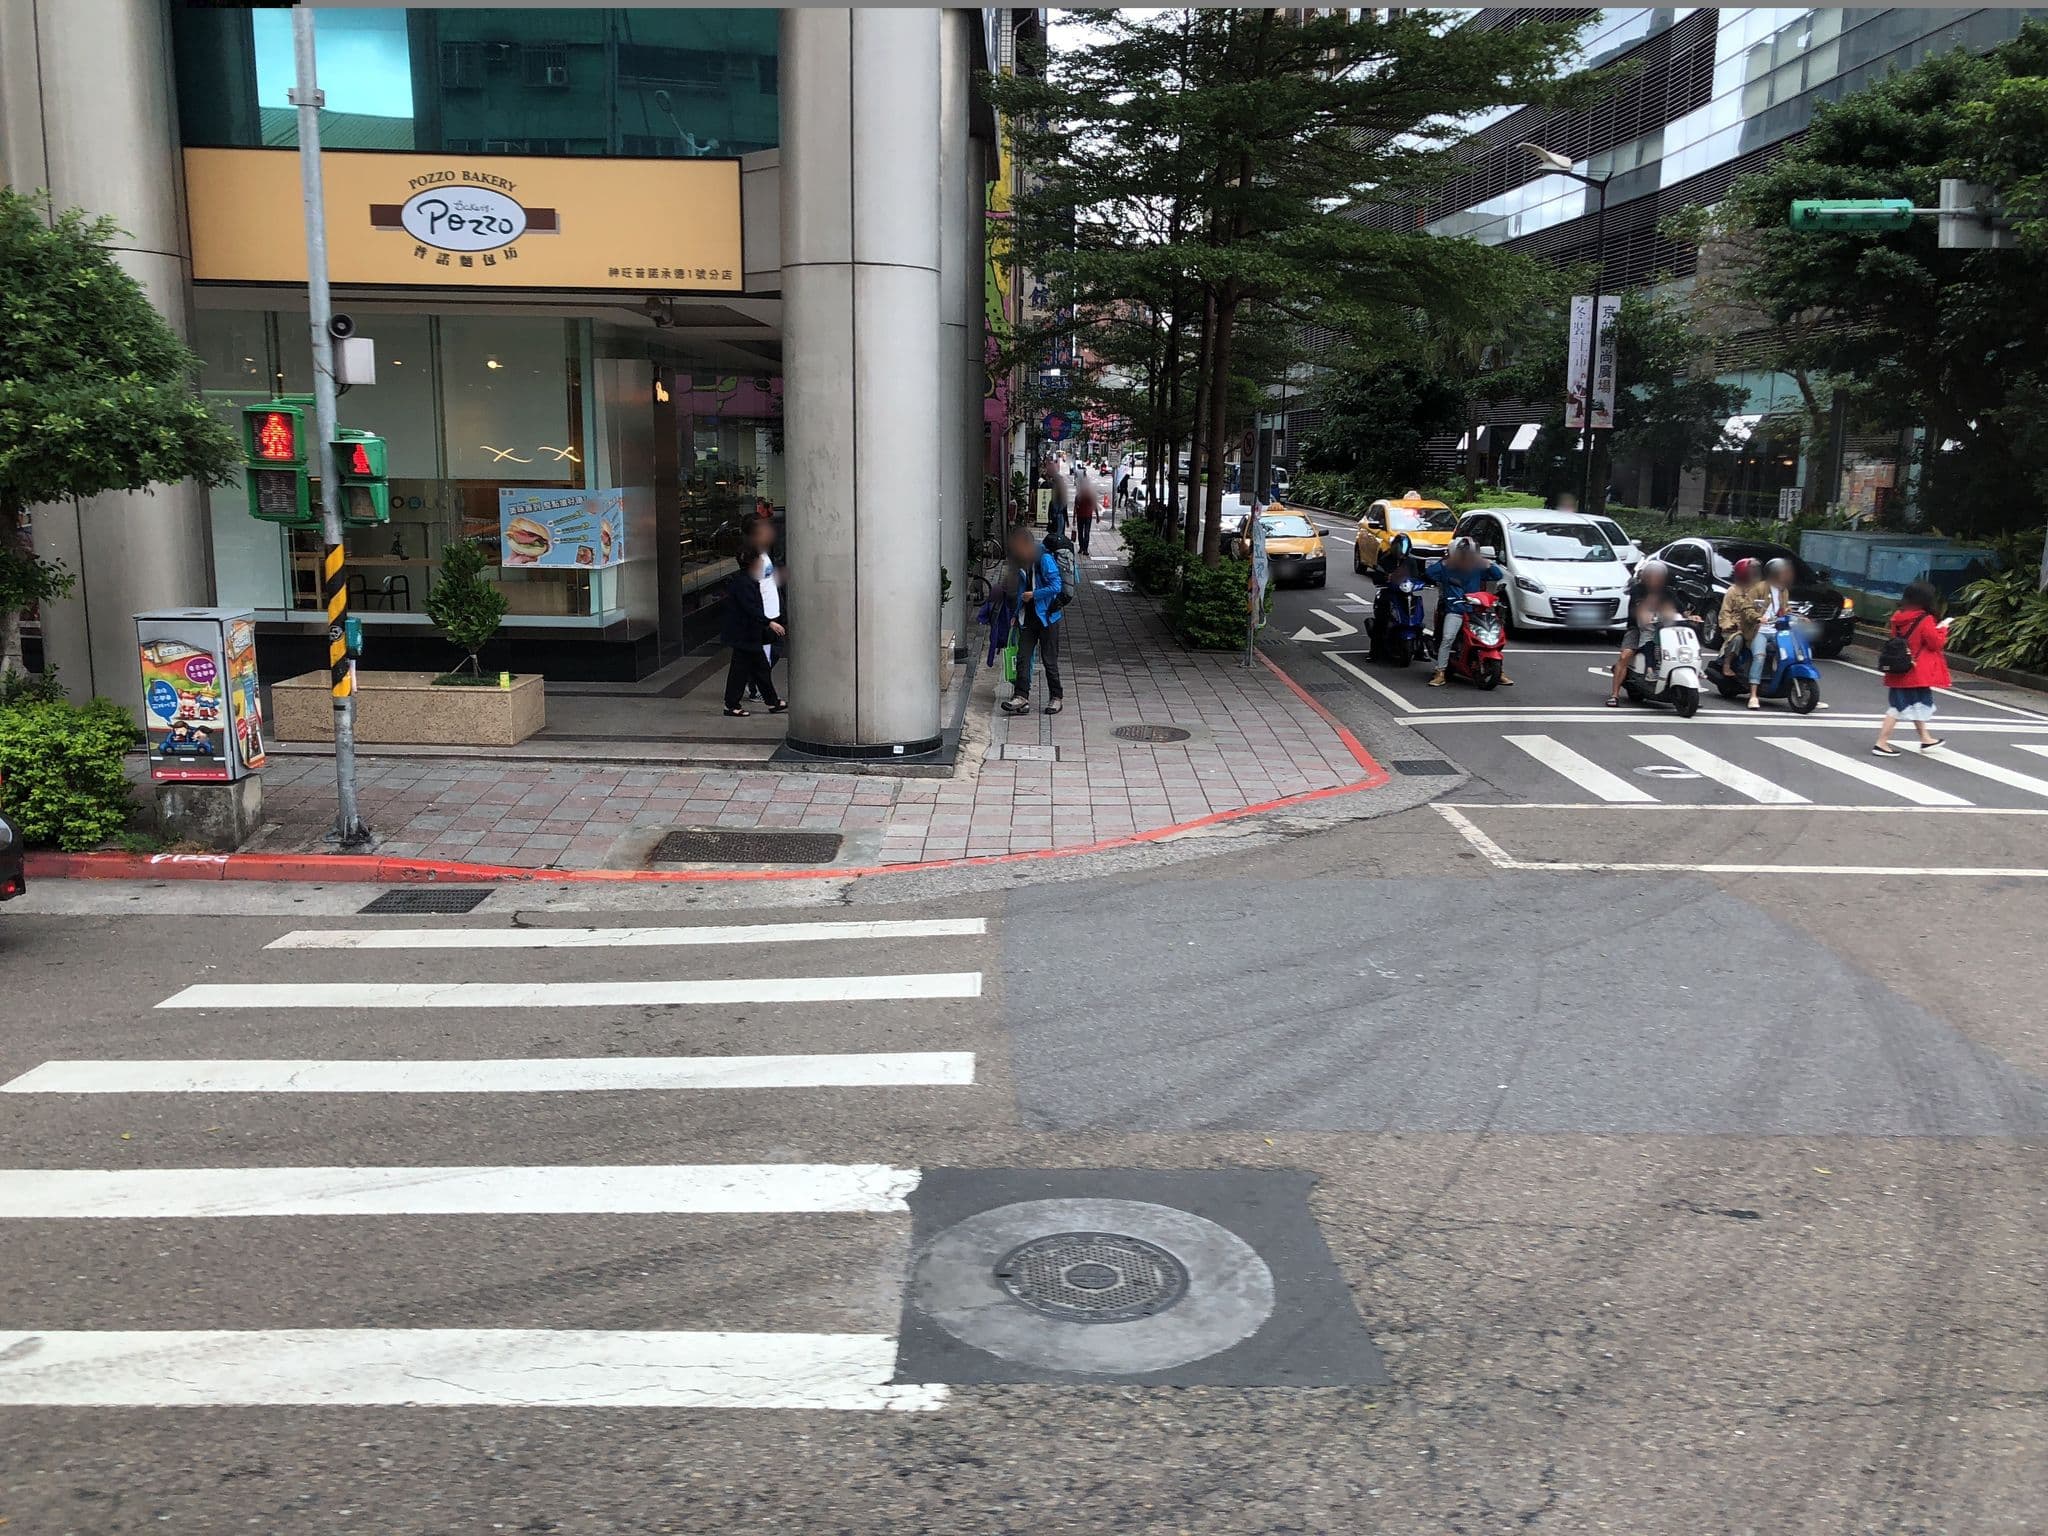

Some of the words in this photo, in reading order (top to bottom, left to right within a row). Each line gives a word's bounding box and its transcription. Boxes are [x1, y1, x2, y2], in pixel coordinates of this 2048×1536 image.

[408, 170, 456, 190] POZZO
[462, 170, 518, 192] BAKERY
[416, 198, 514, 236] Pozzo
[413, 245, 518, 268] 普諾麵包坊
